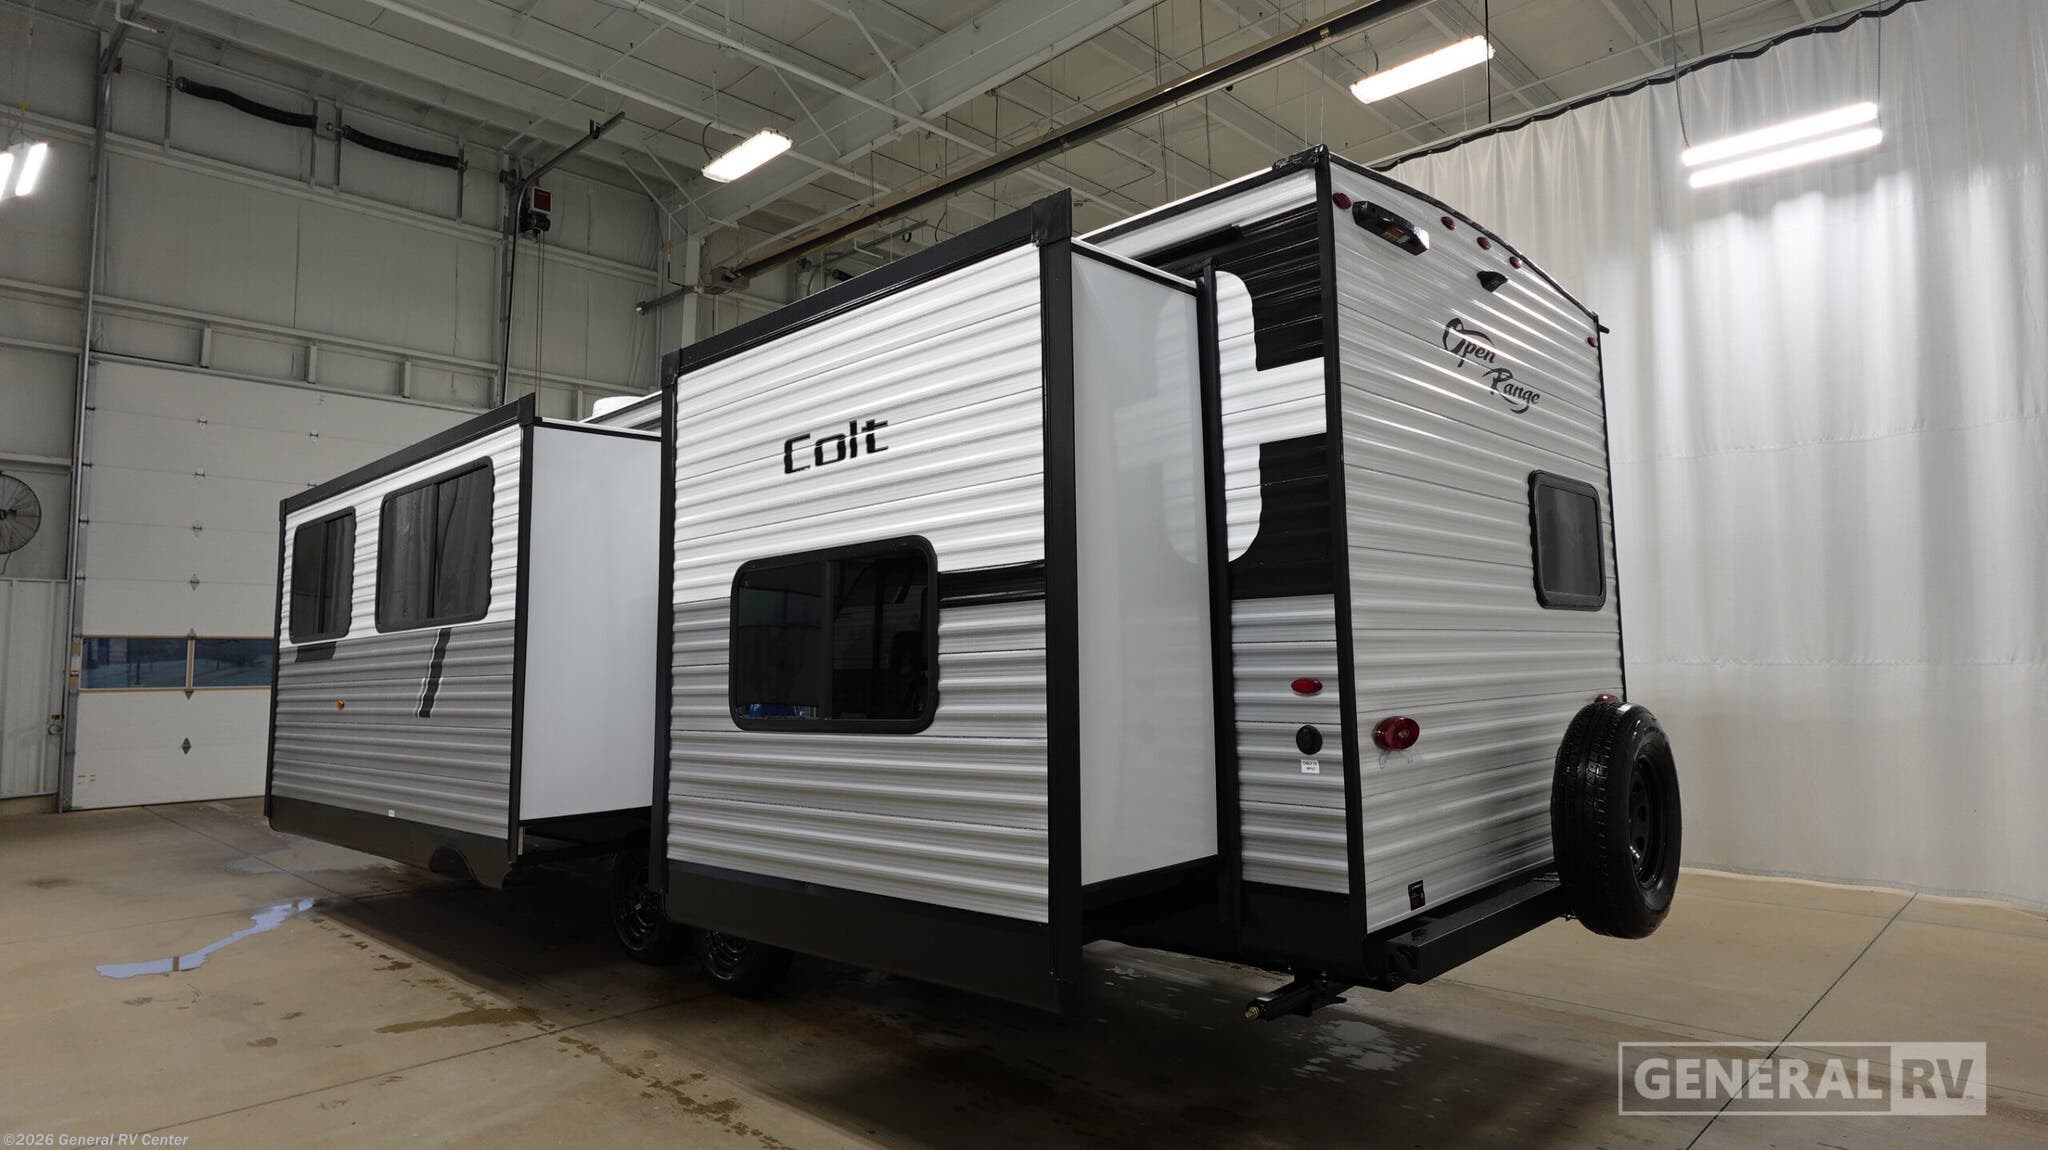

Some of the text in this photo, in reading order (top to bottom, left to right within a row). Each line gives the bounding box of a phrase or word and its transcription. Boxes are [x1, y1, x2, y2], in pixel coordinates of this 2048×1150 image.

[1443, 318, 1495, 368] Open
[1482, 368, 1540, 414] Range
[784, 419, 889, 474] Colt
